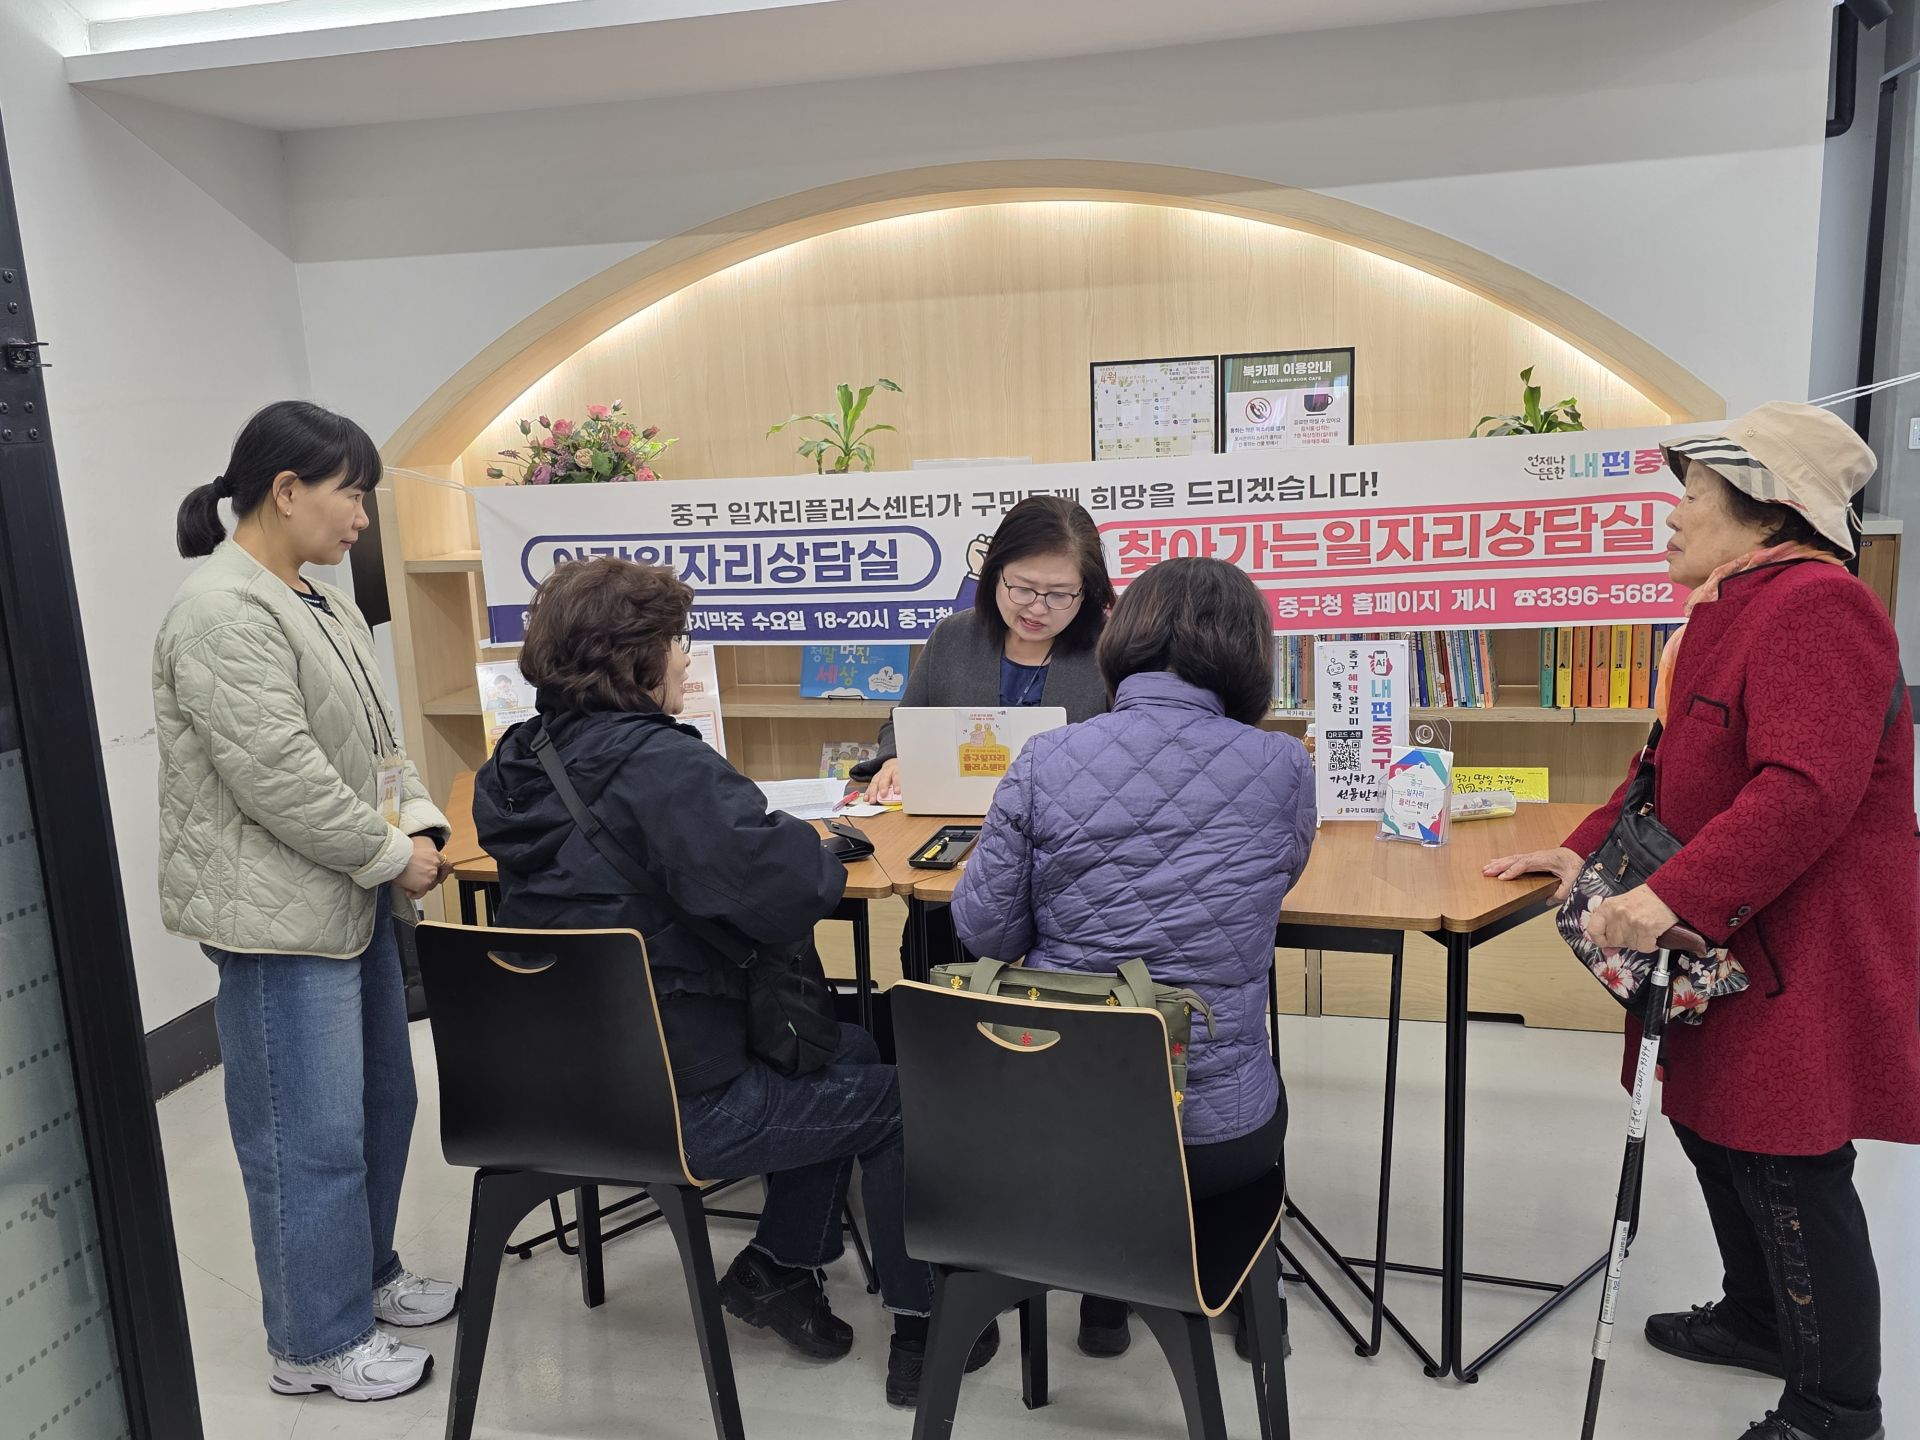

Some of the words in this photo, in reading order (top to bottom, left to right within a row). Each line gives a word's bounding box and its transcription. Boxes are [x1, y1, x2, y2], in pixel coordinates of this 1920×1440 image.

[1243, 363, 1279, 378] 북카페
[1283, 360, 1332, 375] 이용안내
[1527, 453, 1566, 467] 언제나
[1569, 448, 1664, 478] 내편중
[1538, 467, 1565, 481] 든든한
[670, 502, 719, 527] 중구
[727, 492, 963, 526] 일자리플러스센터가
[1091, 481, 1176, 511] 희망을
[1186, 470, 1380, 506] 드리겠습니다!
[1118, 501, 1656, 575] 찾아가는일자리상담실
[1278, 594, 1343, 619] 중구청
[1353, 589, 1441, 617] 홈페이지
[1451, 586, 1497, 613] 게시
[1535, 582, 1674, 608] 3396-5682
[751, 609, 807, 631] 수요일
[813, 608, 890, 630] 18~20시
[1332, 681, 1343, 713] 똑똑한
[1327, 731, 1349, 739] QR코드
[1329, 773, 1376, 786] 가입하고
[1455, 773, 1471, 783] 우리
[1406, 789, 1425, 798] 일자리
[1398, 799, 1430, 810] 플러스센터
